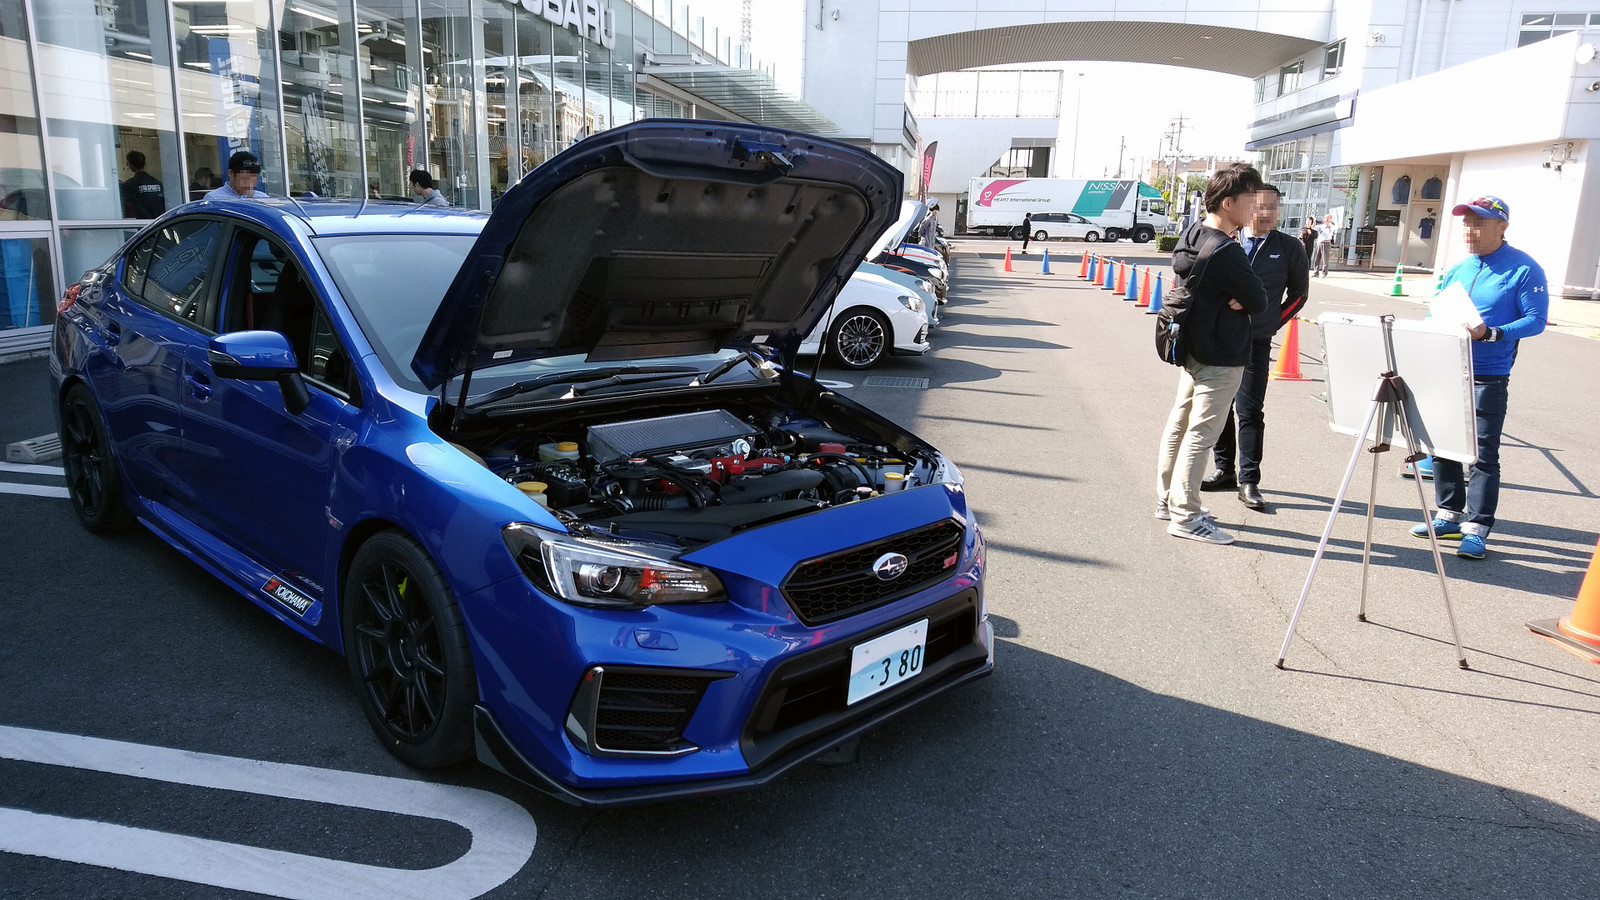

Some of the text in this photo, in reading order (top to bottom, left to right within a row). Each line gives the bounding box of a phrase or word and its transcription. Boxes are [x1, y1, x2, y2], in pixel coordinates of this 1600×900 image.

[506, 0, 616, 50] BARU
[1088, 182, 1130, 191] NISSIN
[274, 584, 308, 611] YOKOHAMA
